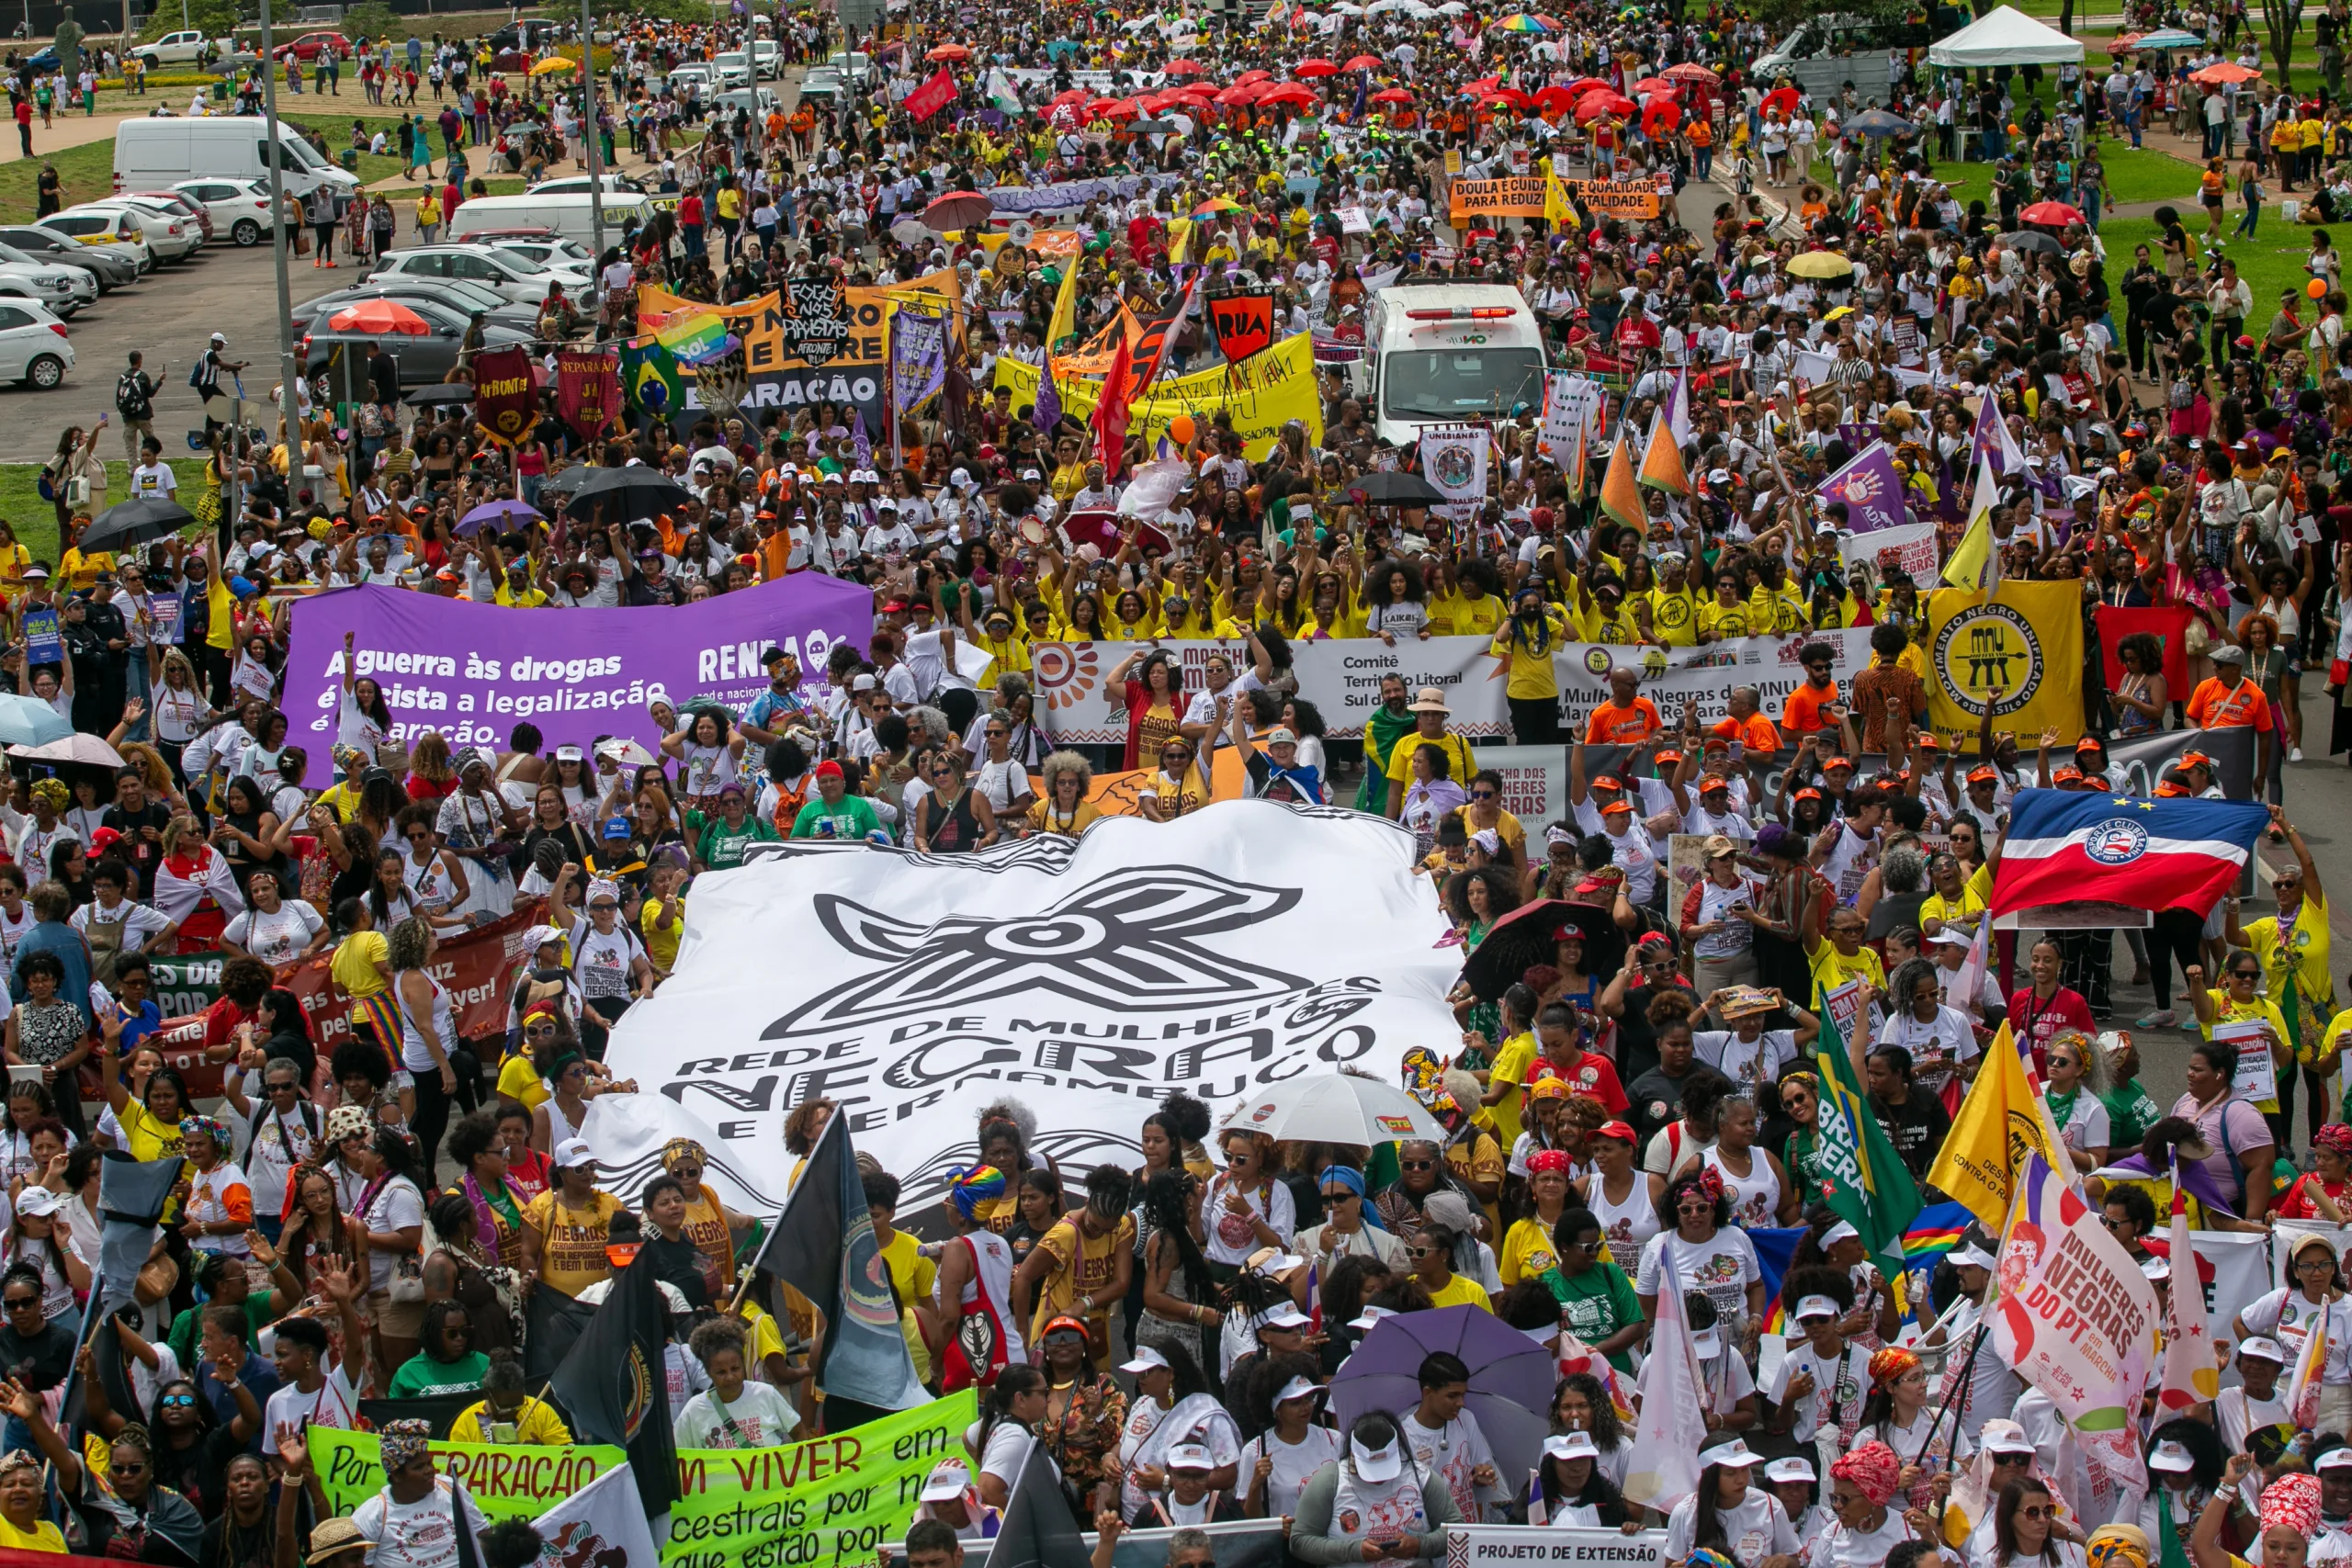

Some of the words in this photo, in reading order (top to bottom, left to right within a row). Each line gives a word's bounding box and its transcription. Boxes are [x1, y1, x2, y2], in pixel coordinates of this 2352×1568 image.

[1456, 183, 1498, 195] DOULA
[1588, 182, 1656, 194] QUALIDADE
[1464, 194, 1498, 208] PARA
[1501, 192, 1546, 206] REDUZI
[788, 284, 837, 303] FOGO
[783, 318, 849, 340] RACISTAS
[1218, 312, 1267, 339] RUA
[1429, 432, 1478, 440] UNEBIANAS
[27, 626, 44, 636] PEC
[28, 618, 46, 628] NÃO
[1343, 655, 1398, 669] Comitê
[1935, 616, 1962, 702] MOVIMENTO
[1966, 604, 2018, 621] NEGRO
[2019, 620, 2043, 701] UNIFICADO
[324, 650, 346, 678] A
[356, 649, 457, 676] guerra
[464, 652, 502, 680] às
[510, 655, 622, 683] drogas
[1416, 671, 1463, 686] Litoral
[317, 684, 336, 709] é
[380, 683, 447, 710] cista
[457, 694, 475, 713] a
[485, 679, 665, 716] legalização
[1344, 694, 1368, 706] Sul
[1655, 688, 1714, 704] Negras
[1753, 681, 1792, 695] MNU
[311, 718, 329, 732] é
[1524, 768, 1546, 779] DAS
[1503, 781, 1546, 795] HERES
[2088, 821, 2112, 855] ESPORTE
[2115, 820, 2144, 838] CLUBE
[660, 992, 1375, 1113] NEGRAS
[676, 1036, 865, 1076] REDE
[888, 1016, 988, 1045] DE
[718, 1120, 757, 1140] E
[1387, 1118, 1413, 1131] CTB
[1953, 1153, 1987, 1185] CONTRA
[1987, 1180, 1996, 1191] O
[1982, 1158, 2008, 1184] DESD
[554, 1224, 607, 1242] NEGRAS
[551, 1251, 566, 1259] POR
[553, 1260, 560, 1270] E
[560, 1260, 582, 1271] BEM
[2059, 1228, 2145, 1337] MULHERES
[2025, 1282, 2062, 1320] DO
[2054, 1306, 2091, 1345] PT
[2042, 1251, 2133, 1360] NEGRAS
[2087, 1332, 2104, 1349] em
[1838, 1359, 1849, 1388] LACOSTE
[2079, 1343, 2118, 1384] MARCHA
[640, 1362, 654, 1405] NEGRAS
[329, 1445, 381, 1486] Por
[428, 1448, 596, 1505] EPARAÇÃO
[731, 1436, 864, 1493] VIVER
[893, 1426, 948, 1462] em
[671, 1493, 807, 1543] cestrais
[823, 1483, 879, 1527] por
[741, 1526, 820, 1568] estão
[835, 1522, 892, 1565] por
[1477, 1544, 1546, 1560] PROJETO
[1552, 1545, 1572, 1561] DE
[1577, 1543, 1657, 1562] EXTENSÃO
